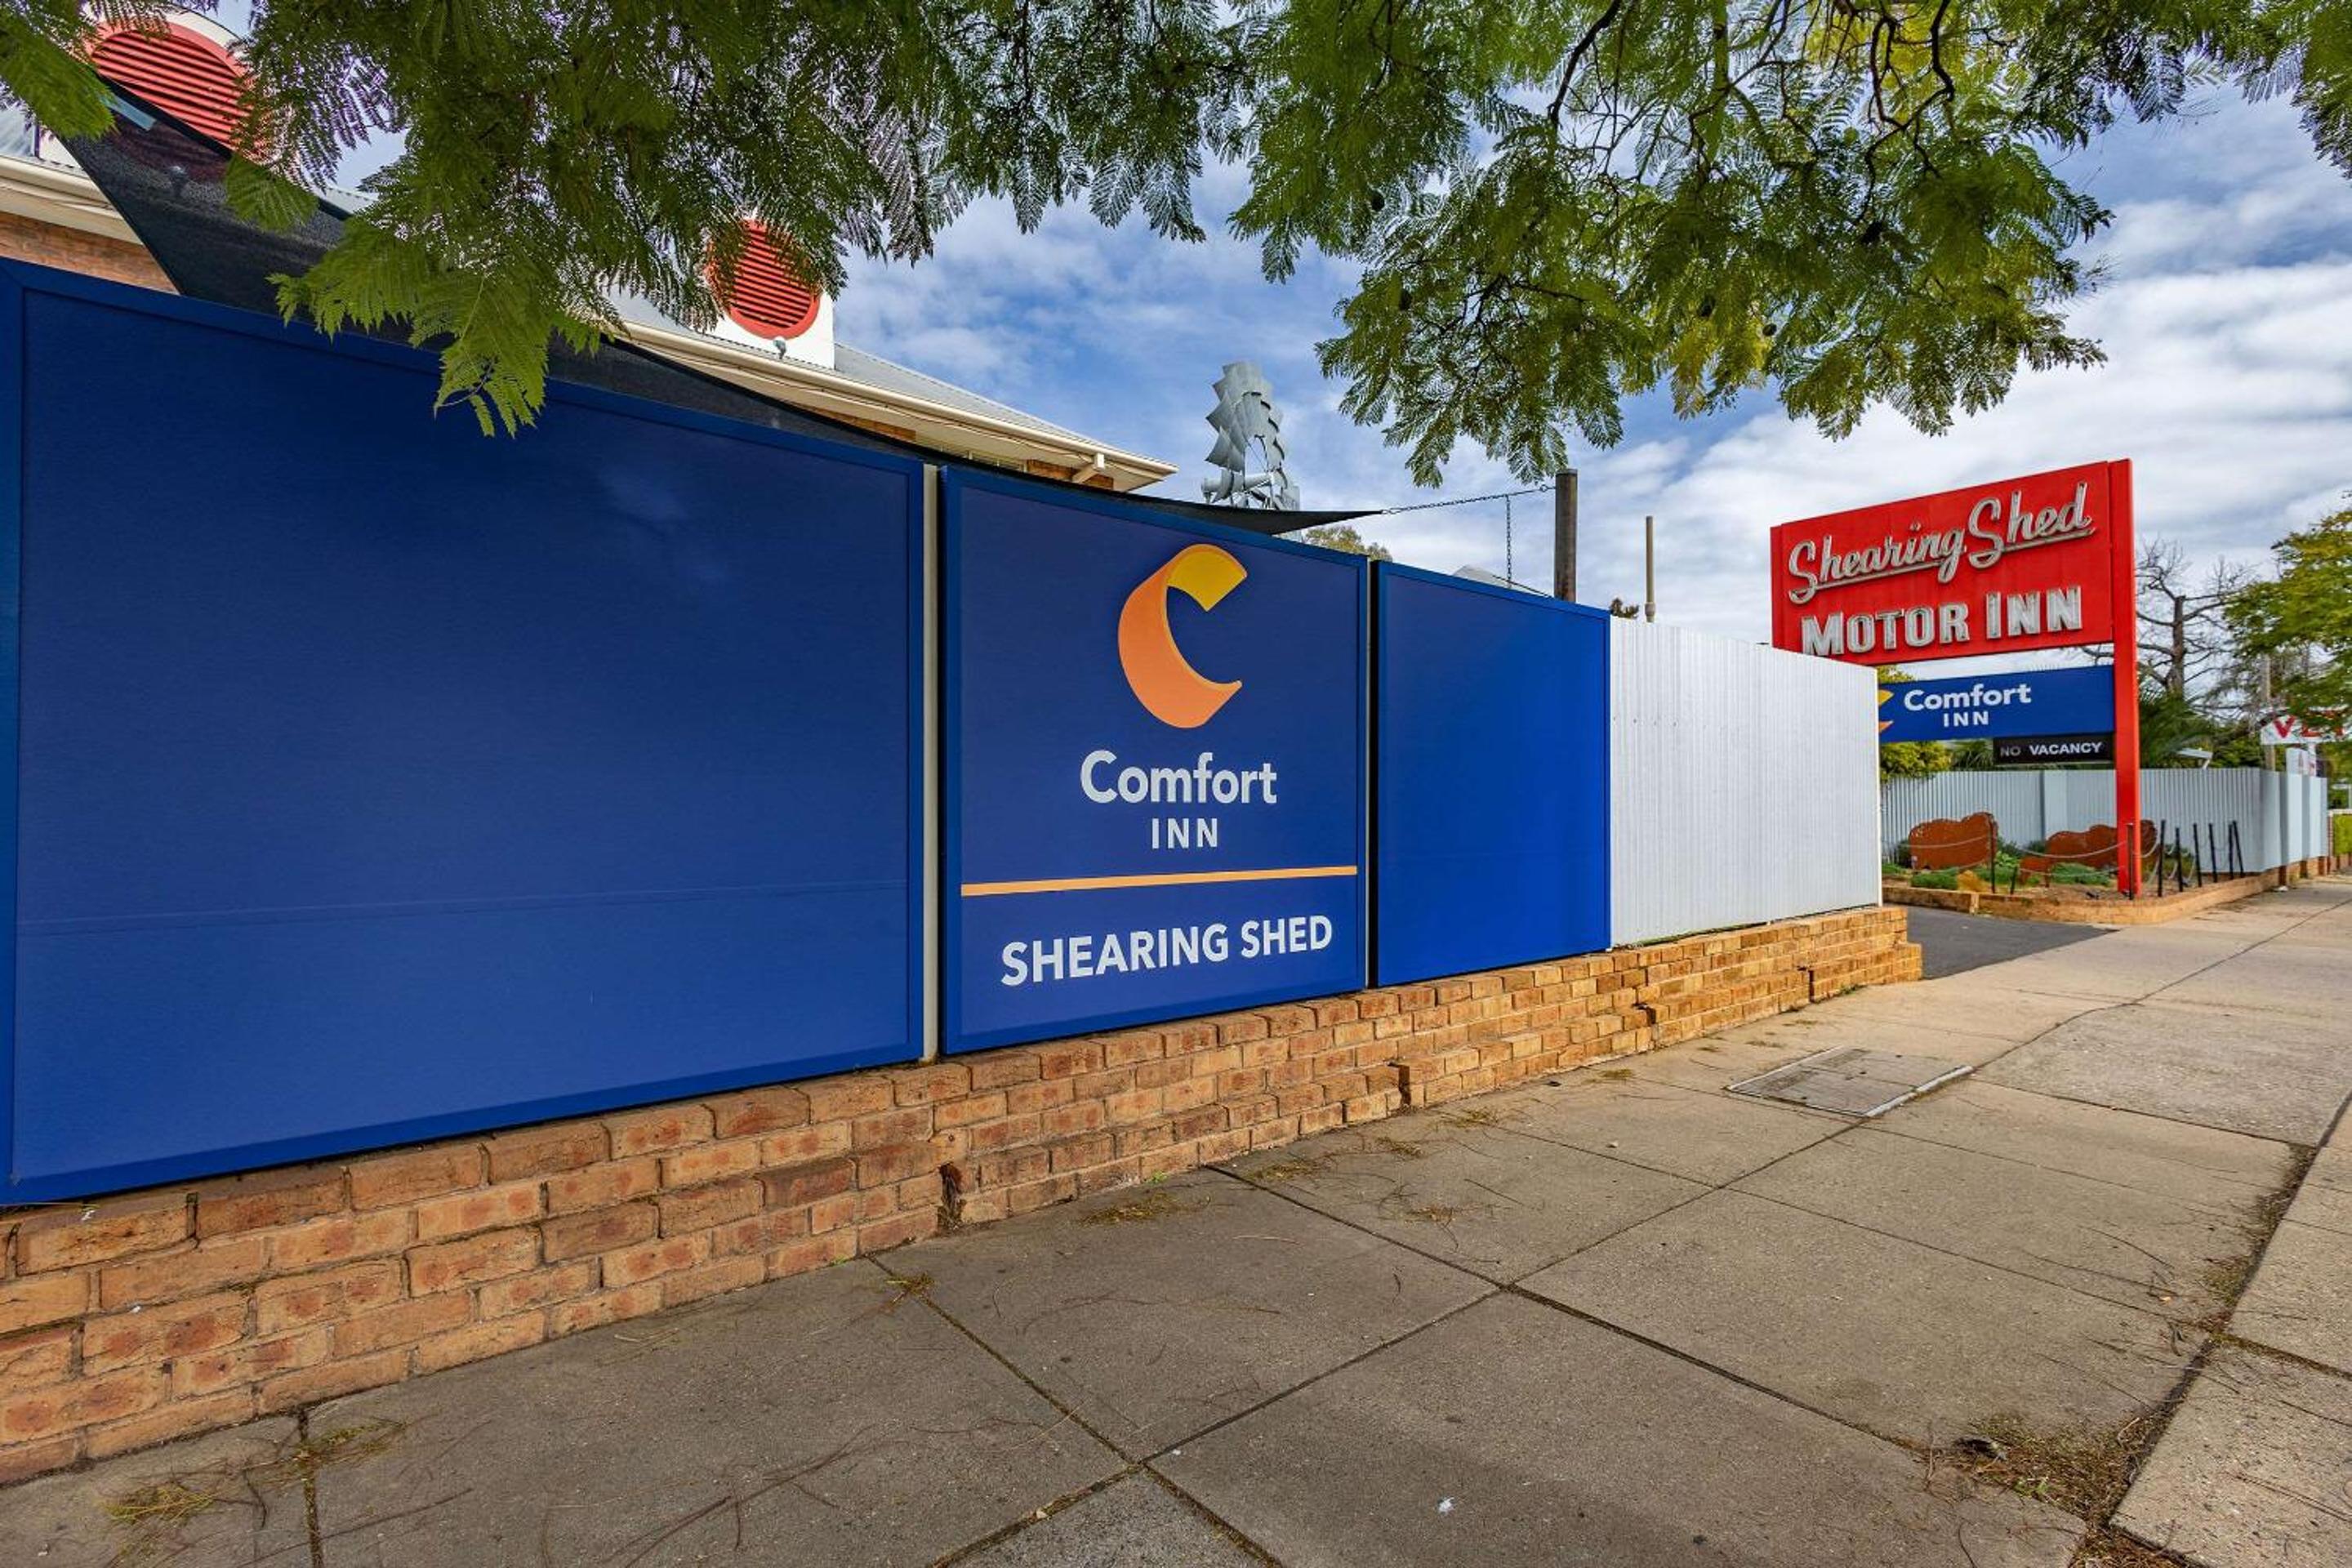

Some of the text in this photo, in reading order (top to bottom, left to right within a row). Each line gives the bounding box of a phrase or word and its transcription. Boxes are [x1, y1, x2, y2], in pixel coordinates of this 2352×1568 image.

[1788, 481, 2096, 604] Shearing Shed
[1801, 584, 2083, 656] MOTOR INN
[1904, 684, 2033, 711] Comfort
[1943, 710, 1990, 728] INN
[2000, 742, 2103, 757] NO VACANCY
[1080, 749, 1277, 804] Comfort
[1151, 817, 1218, 849] INN
[1000, 915, 1333, 986] SHEARING SHED
